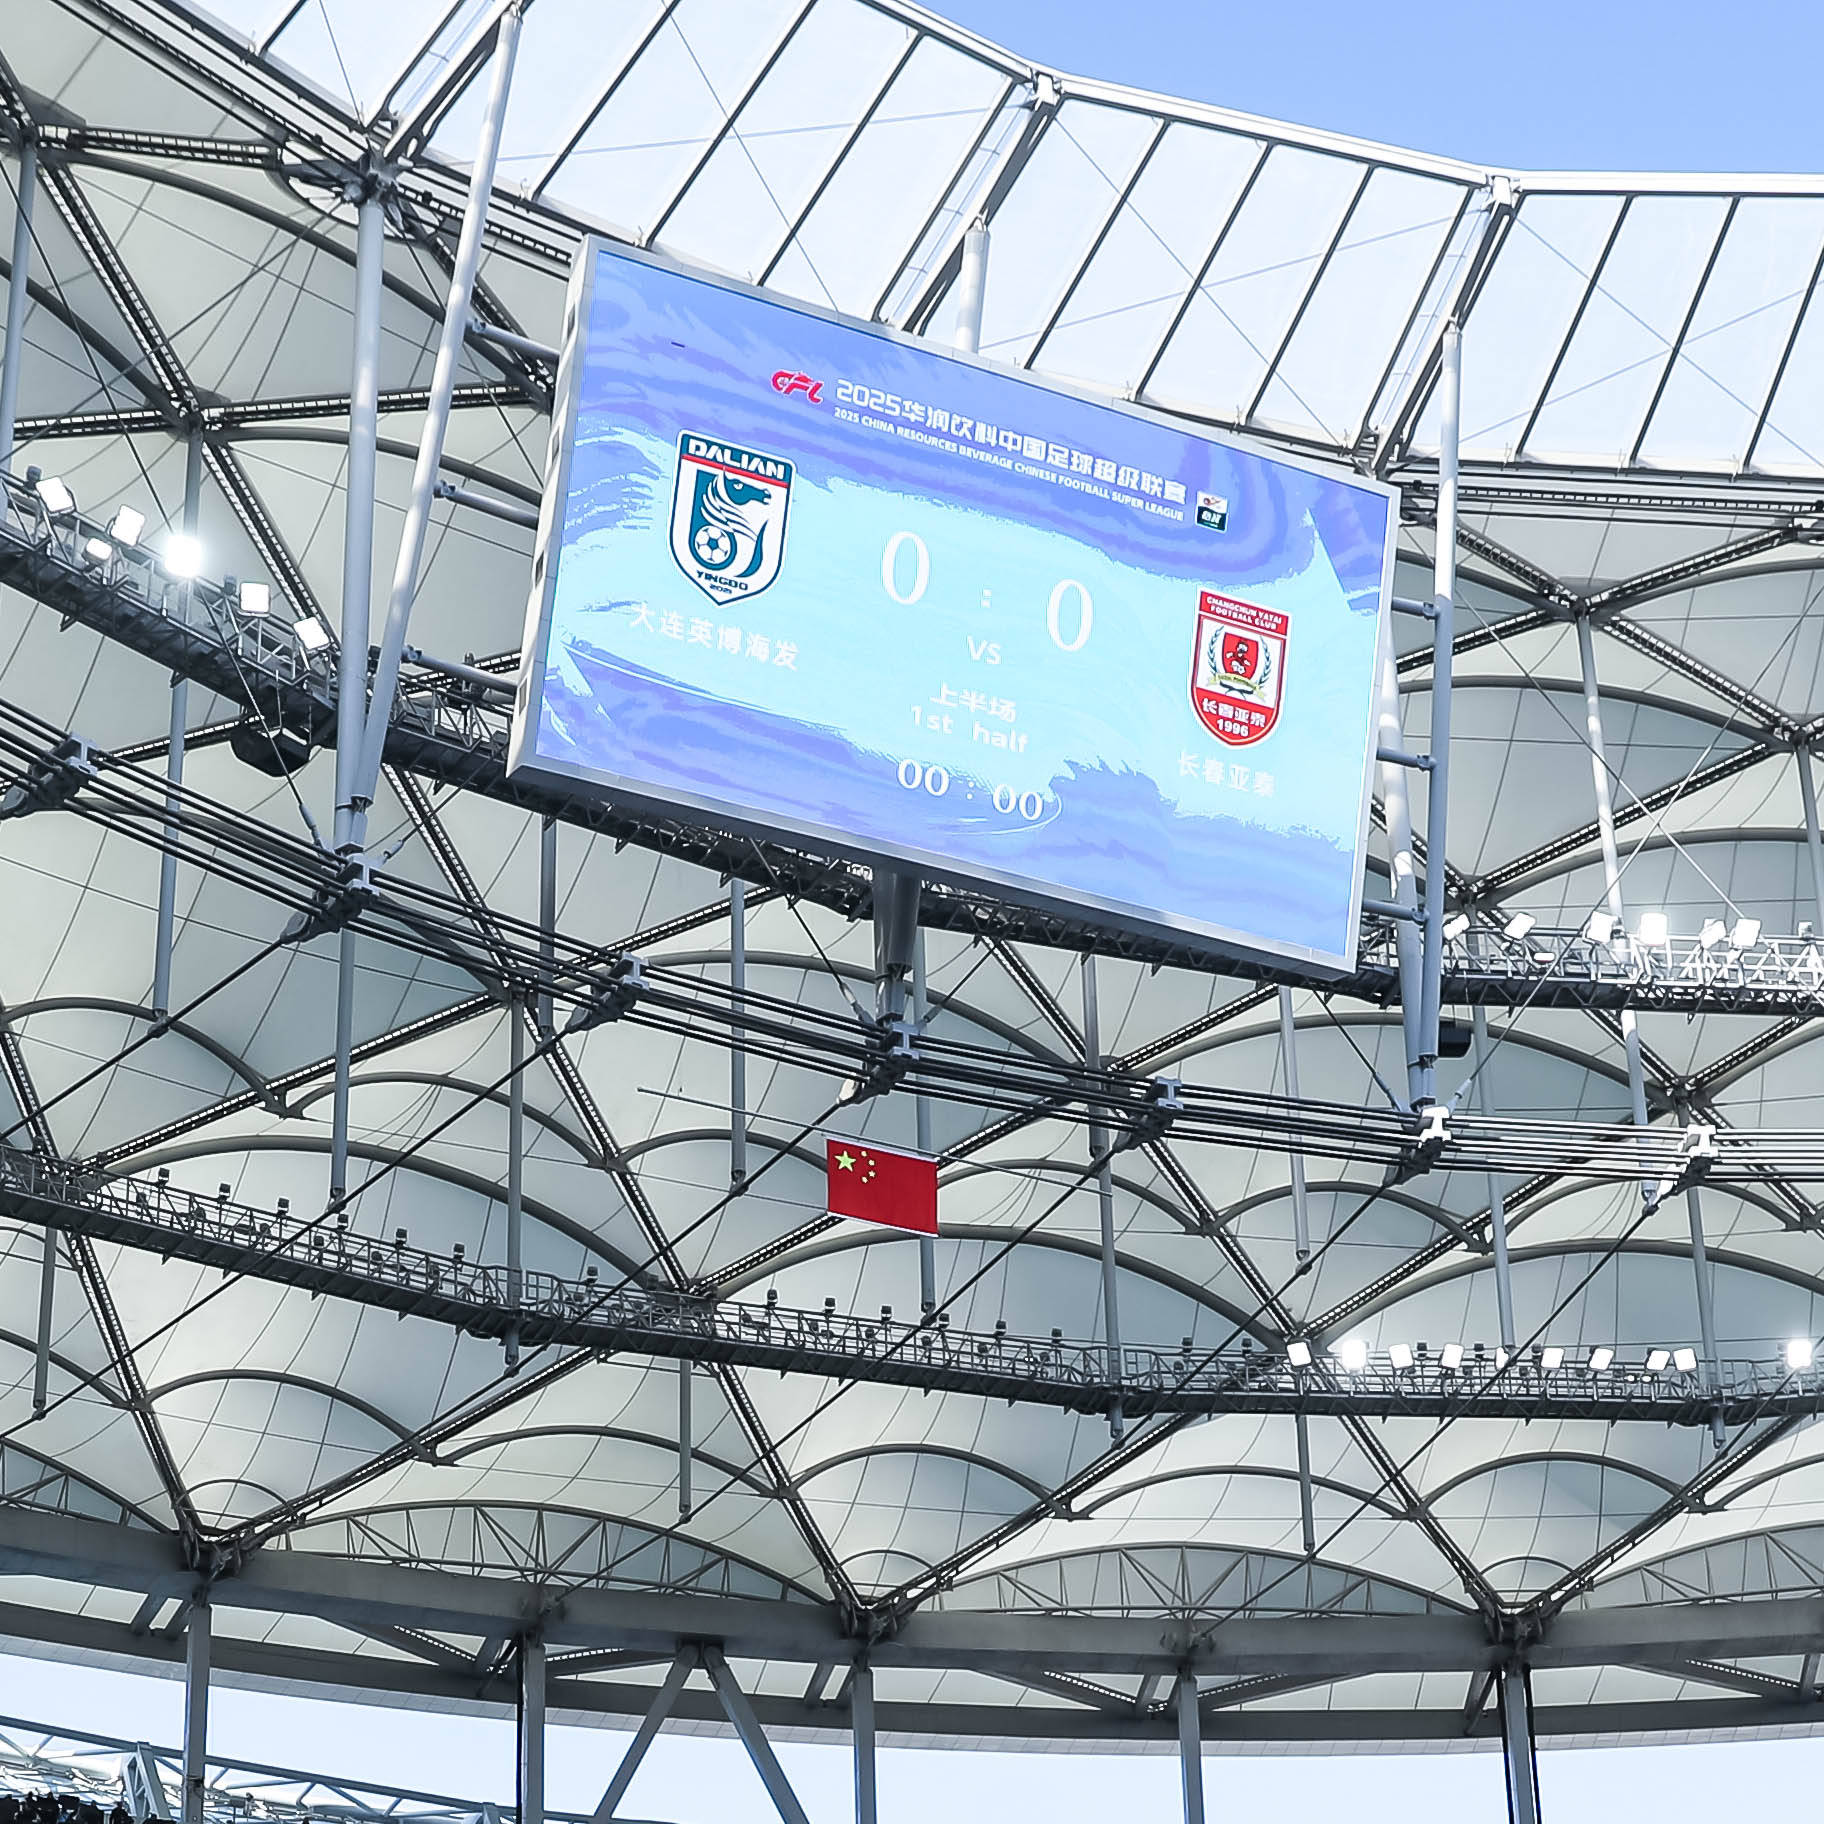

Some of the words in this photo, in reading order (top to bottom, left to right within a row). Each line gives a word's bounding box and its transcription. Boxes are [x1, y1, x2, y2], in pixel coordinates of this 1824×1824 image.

[689, 438, 785, 480] DALIAN
[834, 407, 860, 424] 2025
[861, 415, 895, 435] CHINA
[896, 425, 958, 453] RESOURCES
[959, 445, 1013, 471] BEVERAGE
[1014, 462, 1057, 484] CHINESE
[1058, 475, 1110, 500] FOOTBALL
[1111, 490, 1144, 511] SUPER
[1145, 501, 1184, 522] LEAGUE
[882, 530, 930, 605] 0
[1047, 578, 1093, 651] 0
[1206, 596, 1257, 617] CHANGCHUN
[1258, 610, 1282, 625] YATAI
[630, 603, 799, 671] 大连英博海发
[1210, 606, 1253, 625] FOOTBALL
[1254, 617, 1277, 630] CLUB
[967, 635, 1001, 665] VS
[930, 682, 1016, 723] 上半场
[911, 704, 953, 734] 1st
[973, 721, 1028, 752] half
[1217, 718, 1249, 737] 1996
